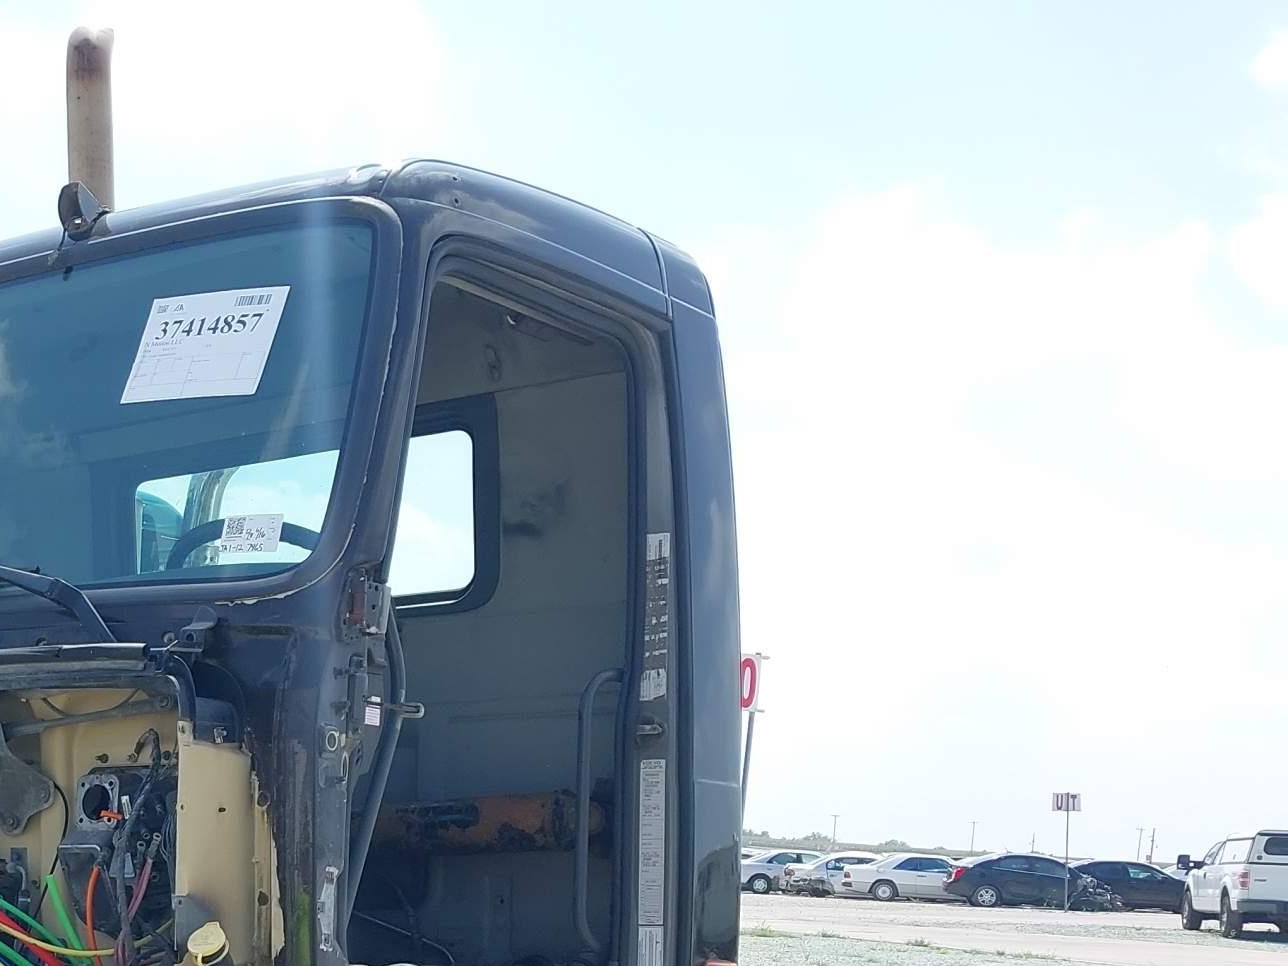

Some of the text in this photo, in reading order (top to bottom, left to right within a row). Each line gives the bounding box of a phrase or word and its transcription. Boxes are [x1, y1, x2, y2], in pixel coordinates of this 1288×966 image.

[154, 312, 264, 340] 37414857
[1056, 794, 1077, 811] U T
